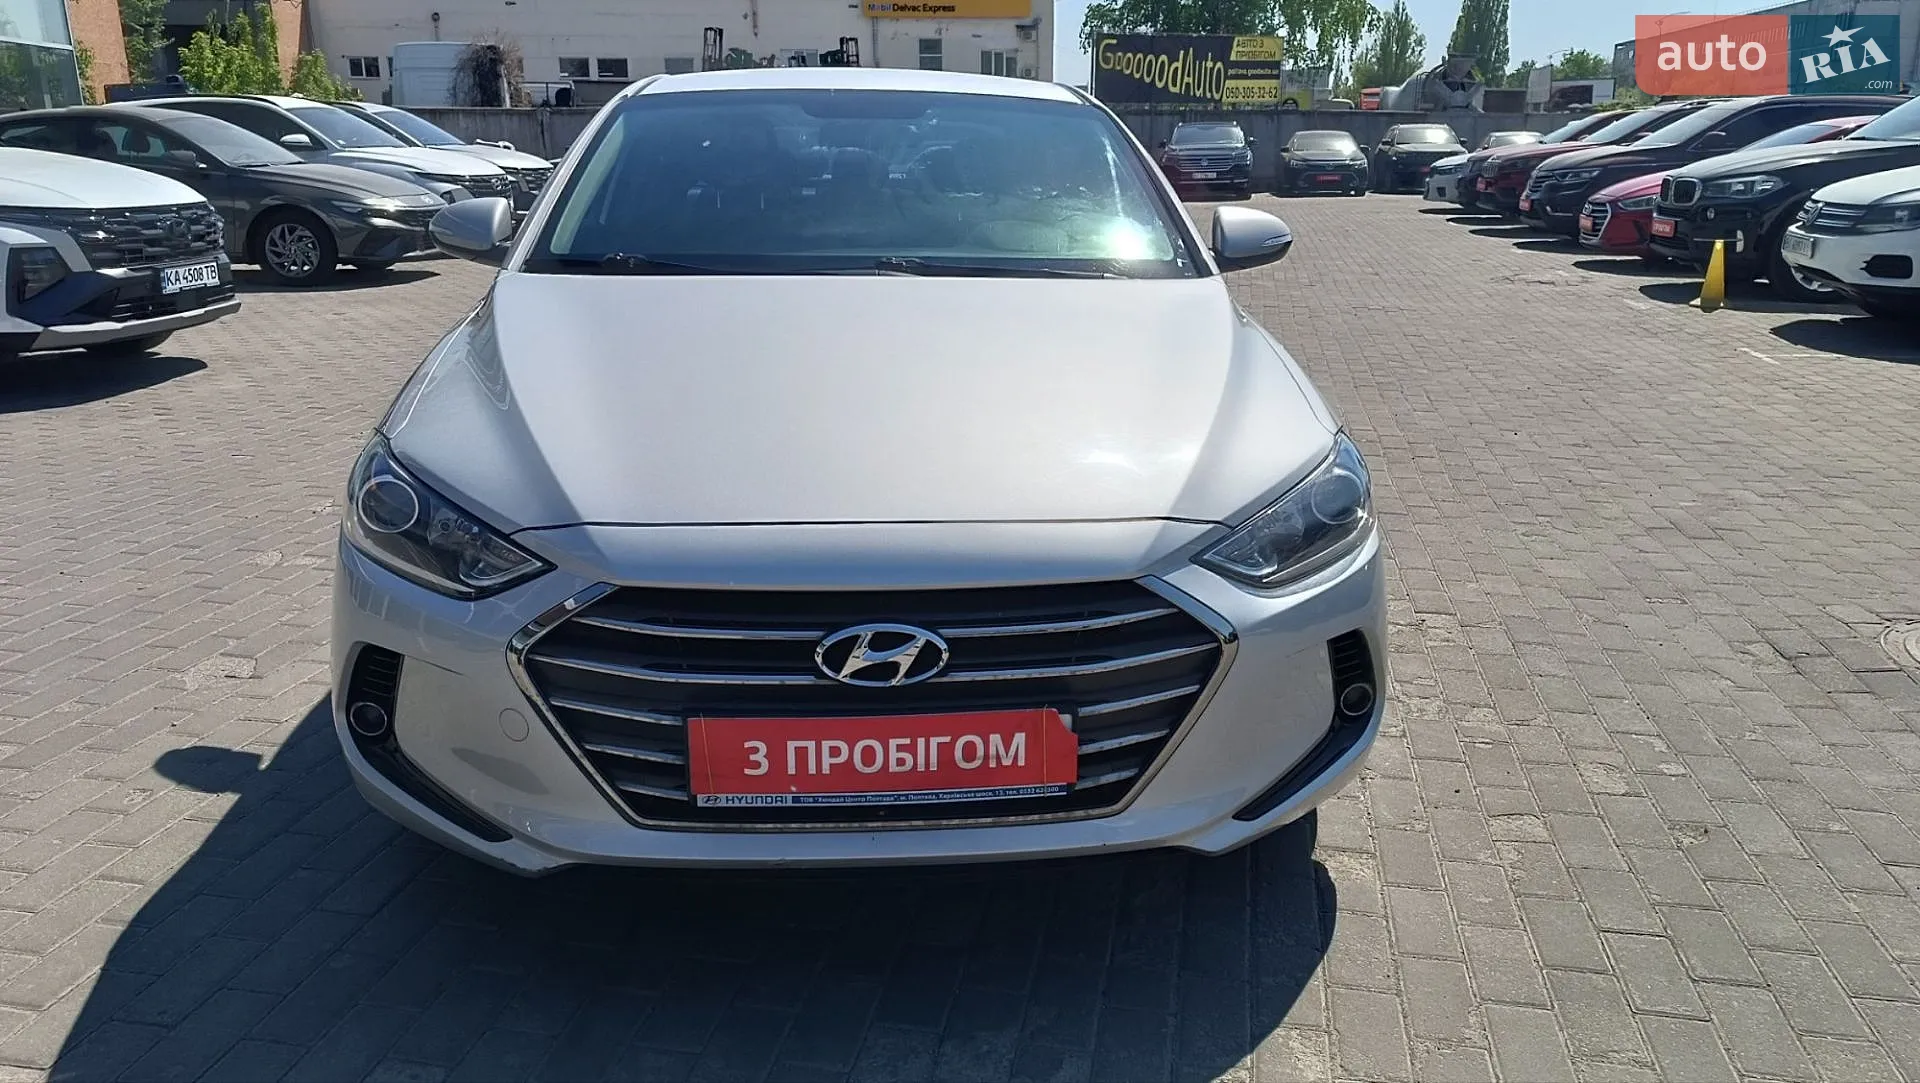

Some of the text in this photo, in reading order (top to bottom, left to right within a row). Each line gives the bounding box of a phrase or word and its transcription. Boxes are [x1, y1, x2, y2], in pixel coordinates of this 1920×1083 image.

[868, 4, 956, 14] Mobil Delvac Express
[1236, 39, 1258, 48] АВТО
[1236, 50, 1276, 60] ПРОБІГОМ
[1225, 86, 1278, 99] 050-305-32-62
[182, 267, 204, 283] 4508
[786, 731, 1026, 776] ПРОБІГОМ
[725, 795, 788, 805] HYUNDAI
